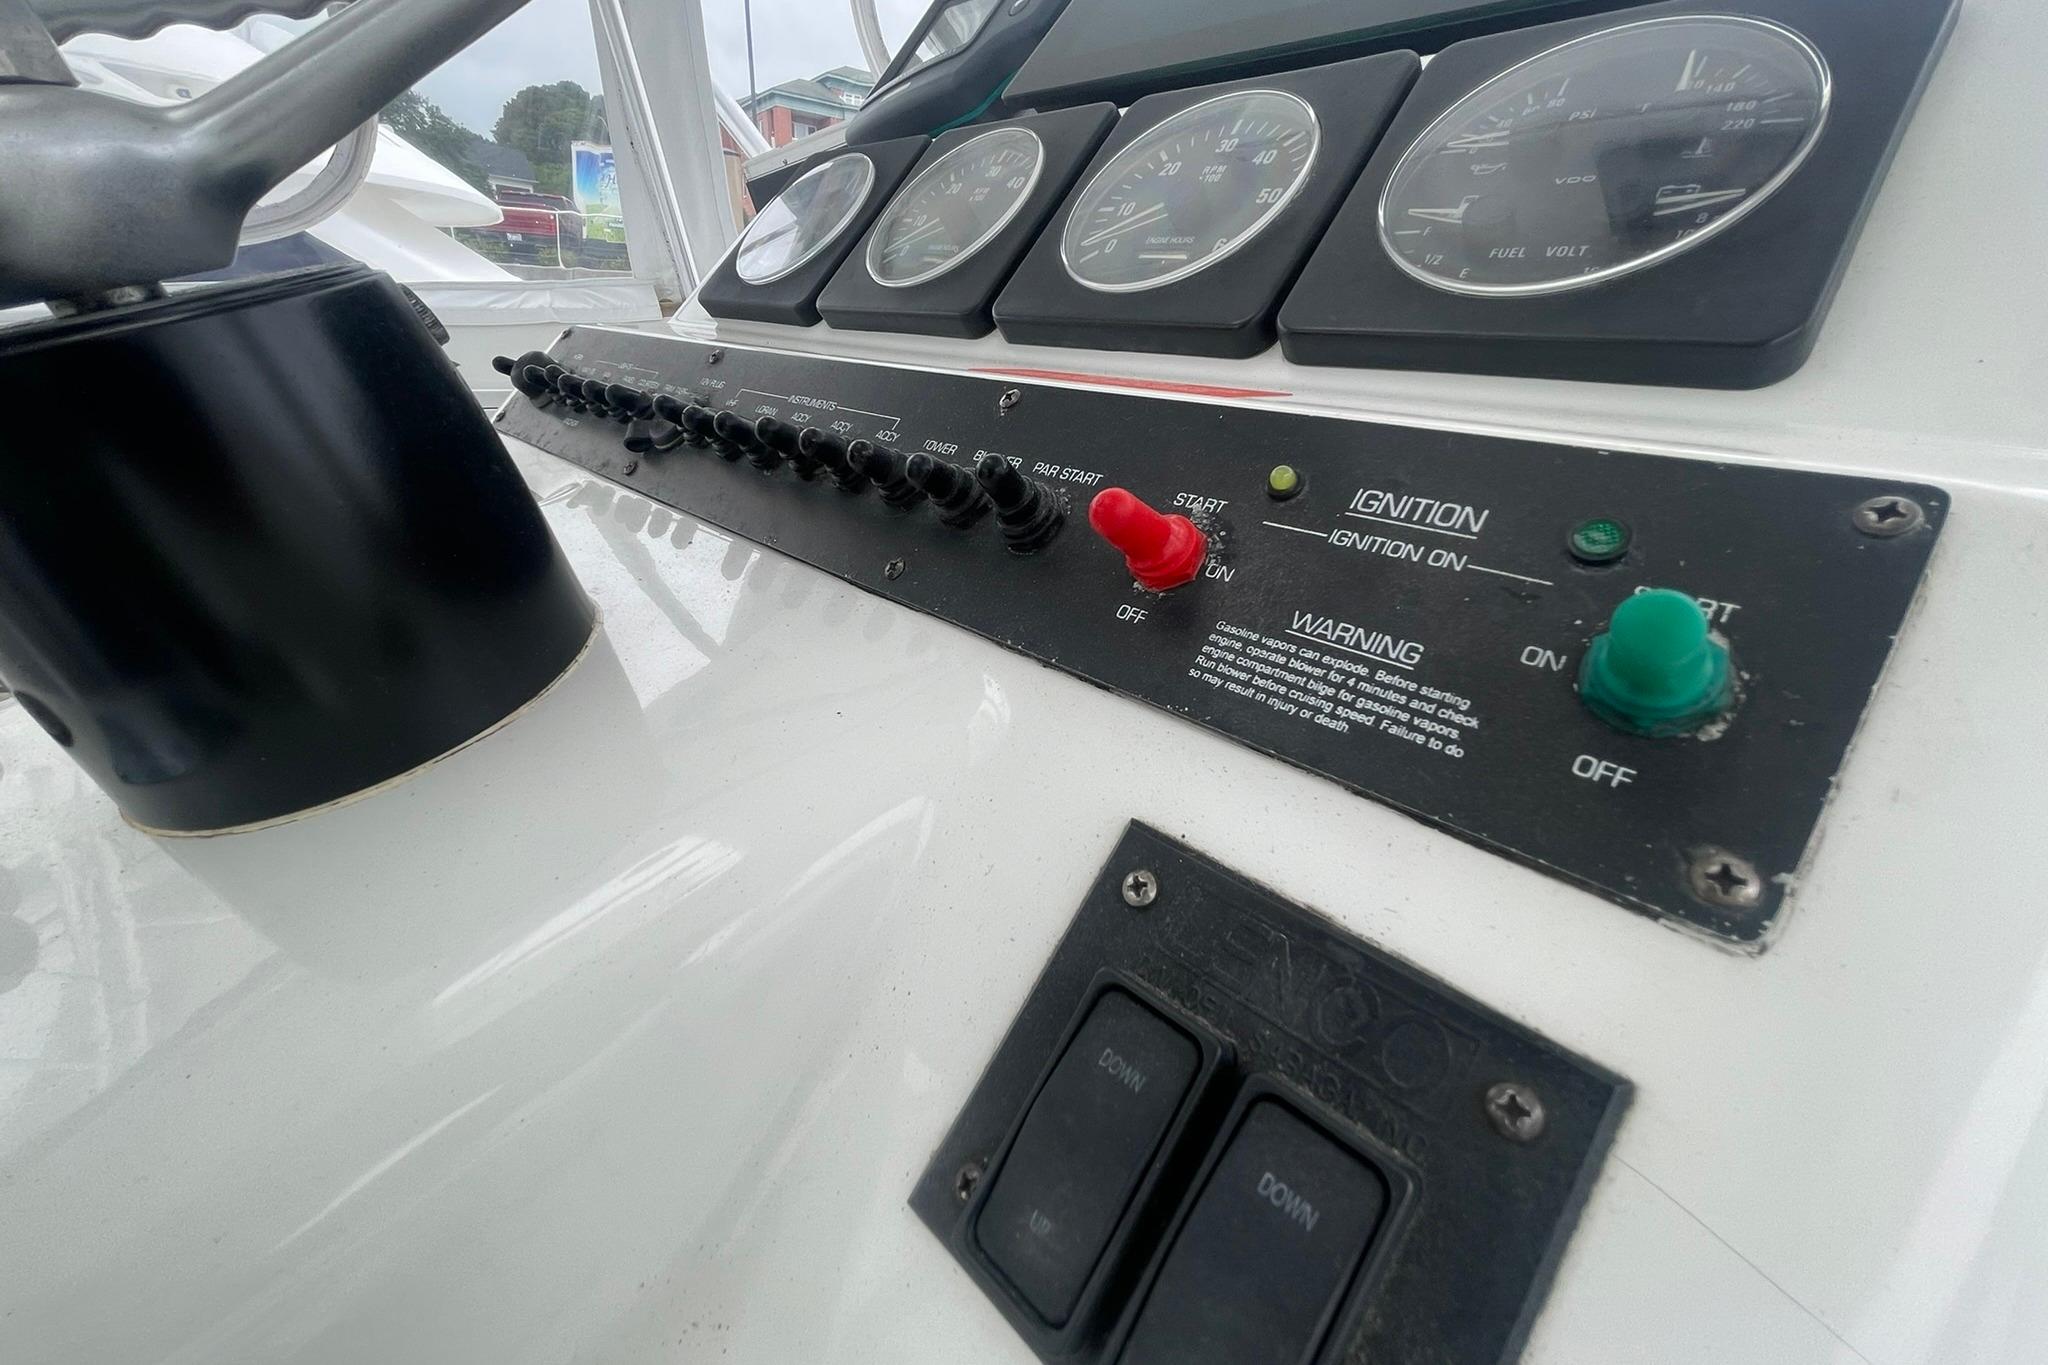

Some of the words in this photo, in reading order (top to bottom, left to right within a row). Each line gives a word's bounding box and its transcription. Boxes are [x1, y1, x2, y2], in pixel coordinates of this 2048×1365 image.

[1569, 108, 1597, 121] PSI
[1726, 100, 1757, 112] 180
[1720, 119, 1756, 131] 220
[1215, 138, 1239, 153] 30
[1252, 150, 1278, 166] 40
[1158, 162, 1182, 176] 20
[1202, 165, 1228, 174] RPM
[1006, 176, 1025, 189] 40
[1255, 188, 1283, 203] 50
[1117, 202, 1136, 216] 10
[1696, 212, 1708, 223] 8
[1104, 239, 1118, 253] 0
[1489, 248, 1526, 258] FUEL
[1546, 245, 1590, 257] VOLT
[1424, 254, 1444, 265] 1/2
[1459, 268, 1470, 278] E
[755, 404, 779, 416] LORAN
[788, 394, 838, 411] INSTRUMENTS
[875, 429, 901, 443] ACCY
[973, 449, 1023, 470] BER
[1032, 461, 1059, 479] PAR
[1059, 467, 1104, 487] START
[1173, 492, 1228, 514] START
[1350, 488, 1489, 534] IGNITION
[1328, 528, 1418, 563] IGNITION
[1428, 548, 1468, 572] ON
[1205, 562, 1236, 583] ON
[1116, 604, 1148, 626] OFF
[1292, 610, 1425, 665] WARNING
[1215, 620, 1260, 641] Gasoline
[1261, 635, 1298, 653] vapors
[1298, 647, 1321, 661] can
[1374, 669, 1418, 692] Before
[1419, 686, 1471, 711] starting
[1520, 644, 1567, 672] ON
[1201, 644, 1235, 663] engine
[1235, 655, 1308, 687] compartment
[1306, 678, 1336, 697] bilge
[1337, 688, 1356, 703] for
[1355, 697, 1411, 722] gasoline
[1245, 645, 1288, 665] operate
[1287, 657, 1328, 678] blower
[1327, 669, 1346, 684] for
[1346, 677, 1357, 687] 4
[1357, 681, 1408, 704] minutes
[1408, 698, 1438, 714] and
[1437, 708, 1479, 729] check
[1188, 667, 1201, 679] so
[1201, 672, 1225, 688] may
[1224, 680, 1257, 699] result
[1255, 690, 1267, 703] in
[1266, 694, 1299, 716] injury
[1299, 708, 1314, 720] or
[1195, 654, 1217, 670] Run
[1216, 662, 1253, 682] blower
[1252, 674, 1288, 695] before
[1288, 688, 1334, 713] cruising
[1379, 719, 1426, 744] Failure
[1427, 736, 1443, 750] to
[1444, 743, 1465, 758] do
[1571, 753, 1638, 788] OFF
[1097, 1046, 1147, 1094] DOWN
[1256, 1170, 1320, 1232] DOWN
[1029, 1208, 1052, 1238] UP
